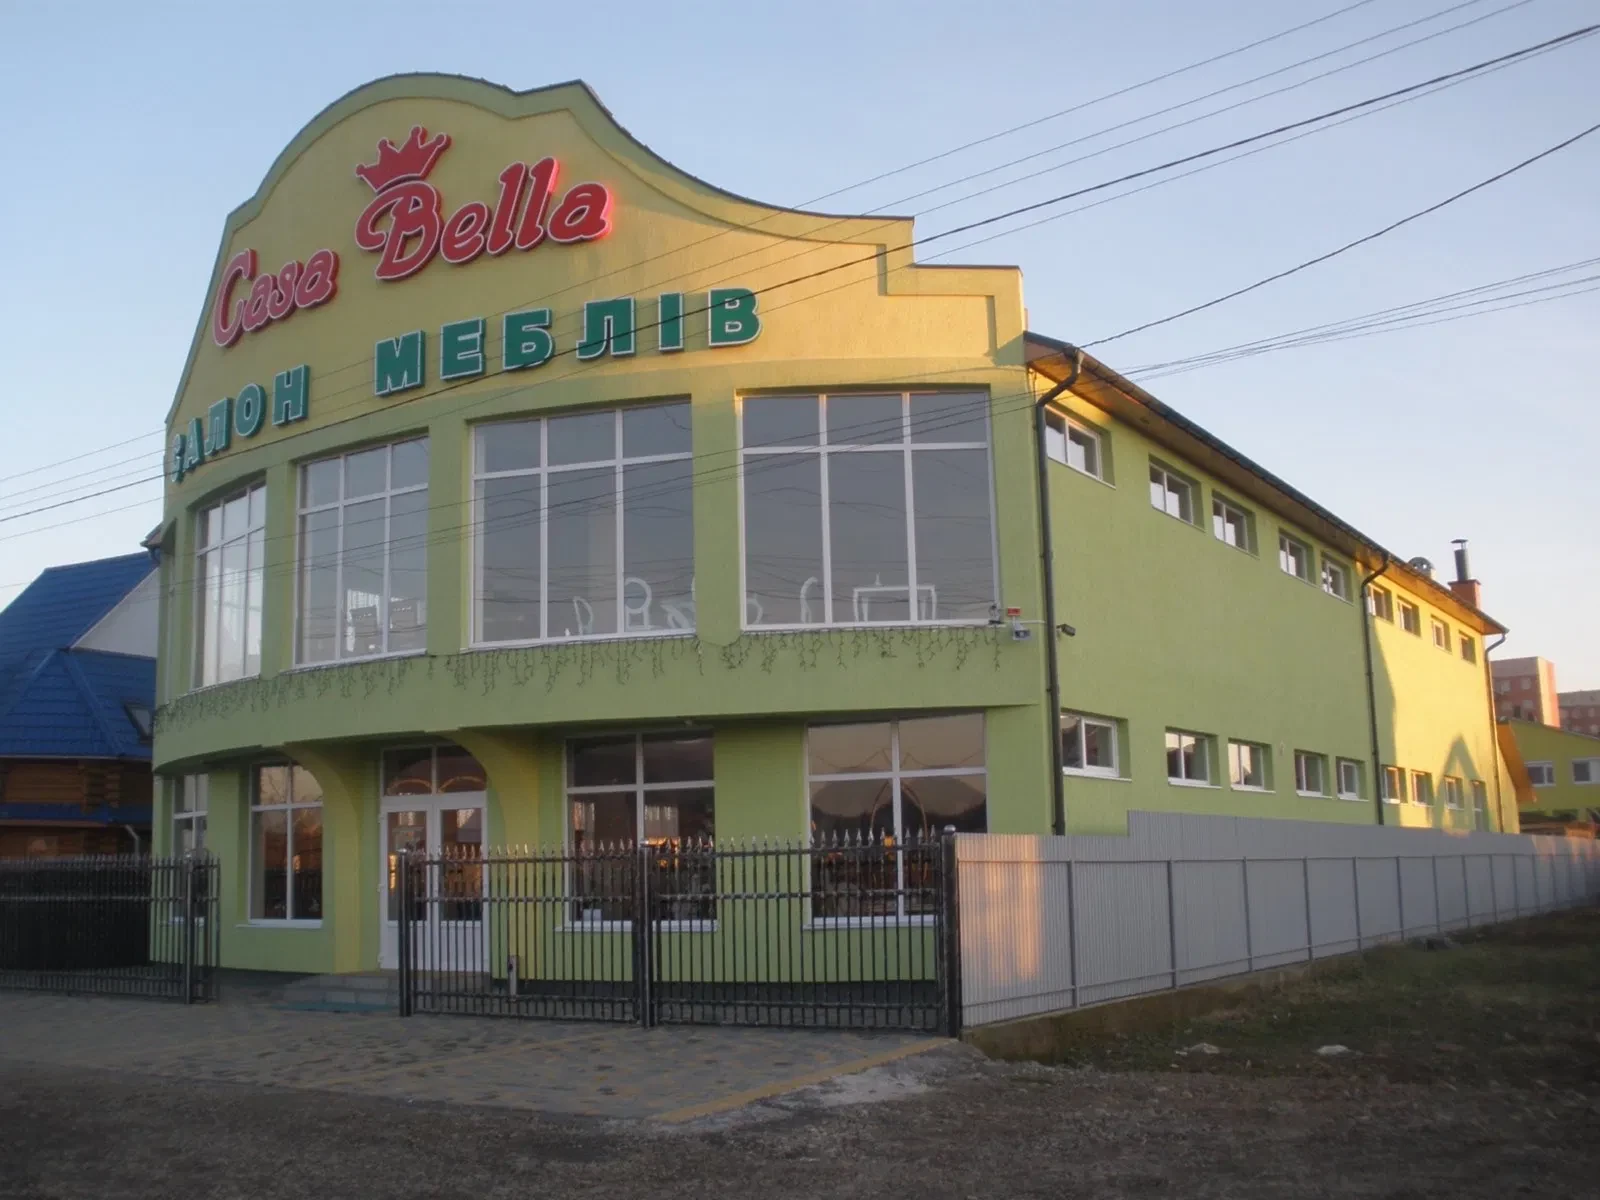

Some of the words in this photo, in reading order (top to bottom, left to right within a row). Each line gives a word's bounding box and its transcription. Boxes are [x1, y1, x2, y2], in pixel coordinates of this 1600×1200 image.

[213, 248, 339, 347] Casa
[355, 156, 612, 280] Bella
[374, 287, 761, 397] МЕБЛІВ
